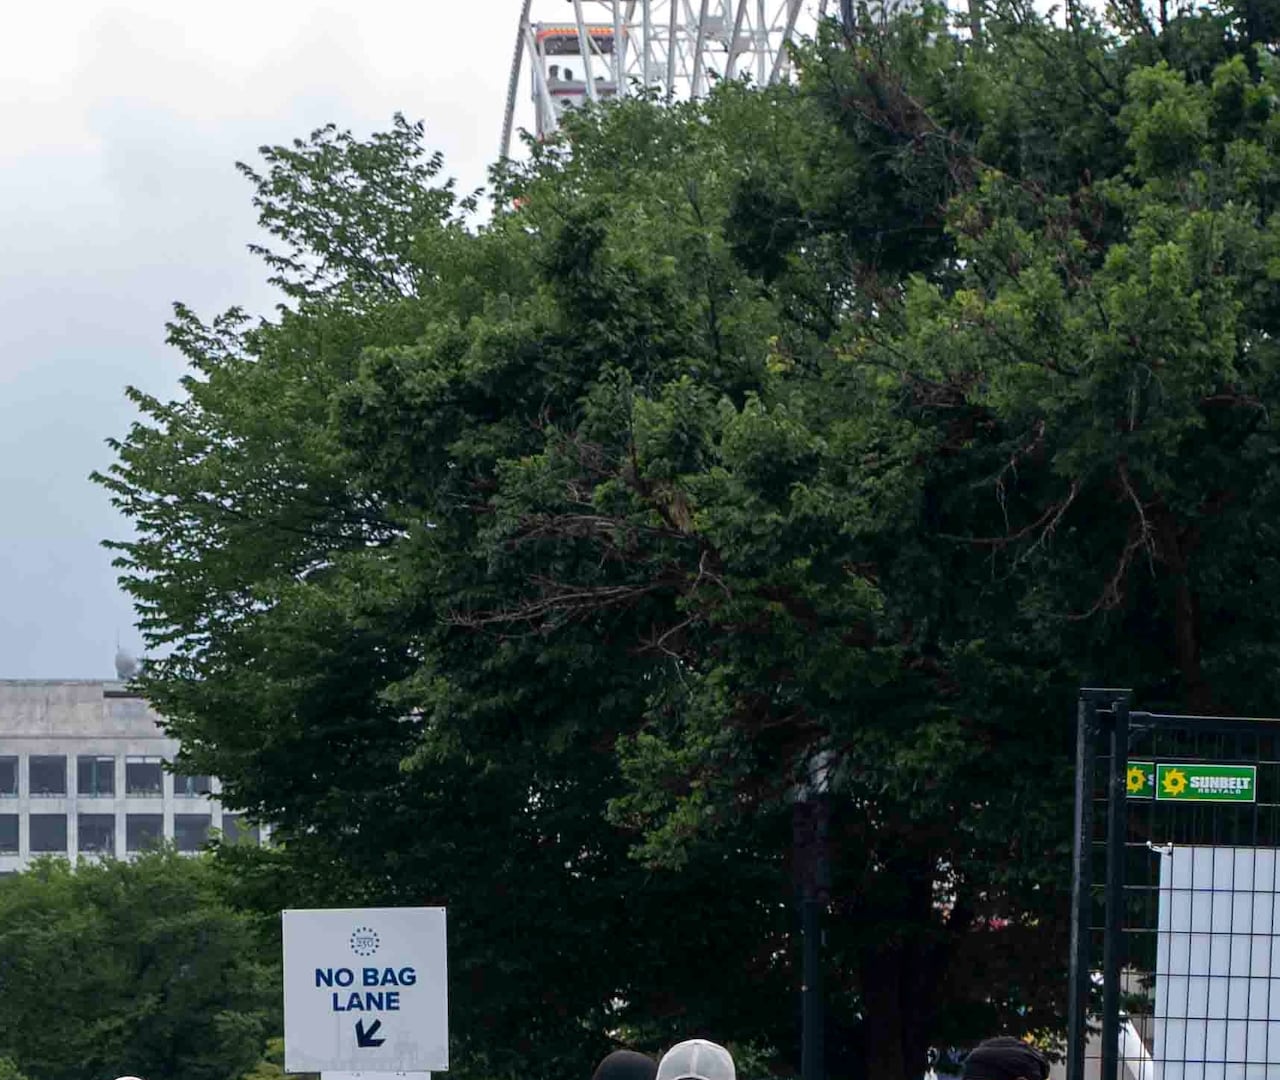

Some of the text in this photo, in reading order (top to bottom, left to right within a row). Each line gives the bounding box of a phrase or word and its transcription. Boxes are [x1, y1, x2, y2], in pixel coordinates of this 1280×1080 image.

[1190, 776, 1251, 790] SUNBELT
[315, 967, 417, 988] NO BAG
[332, 992, 400, 1012] LANE
